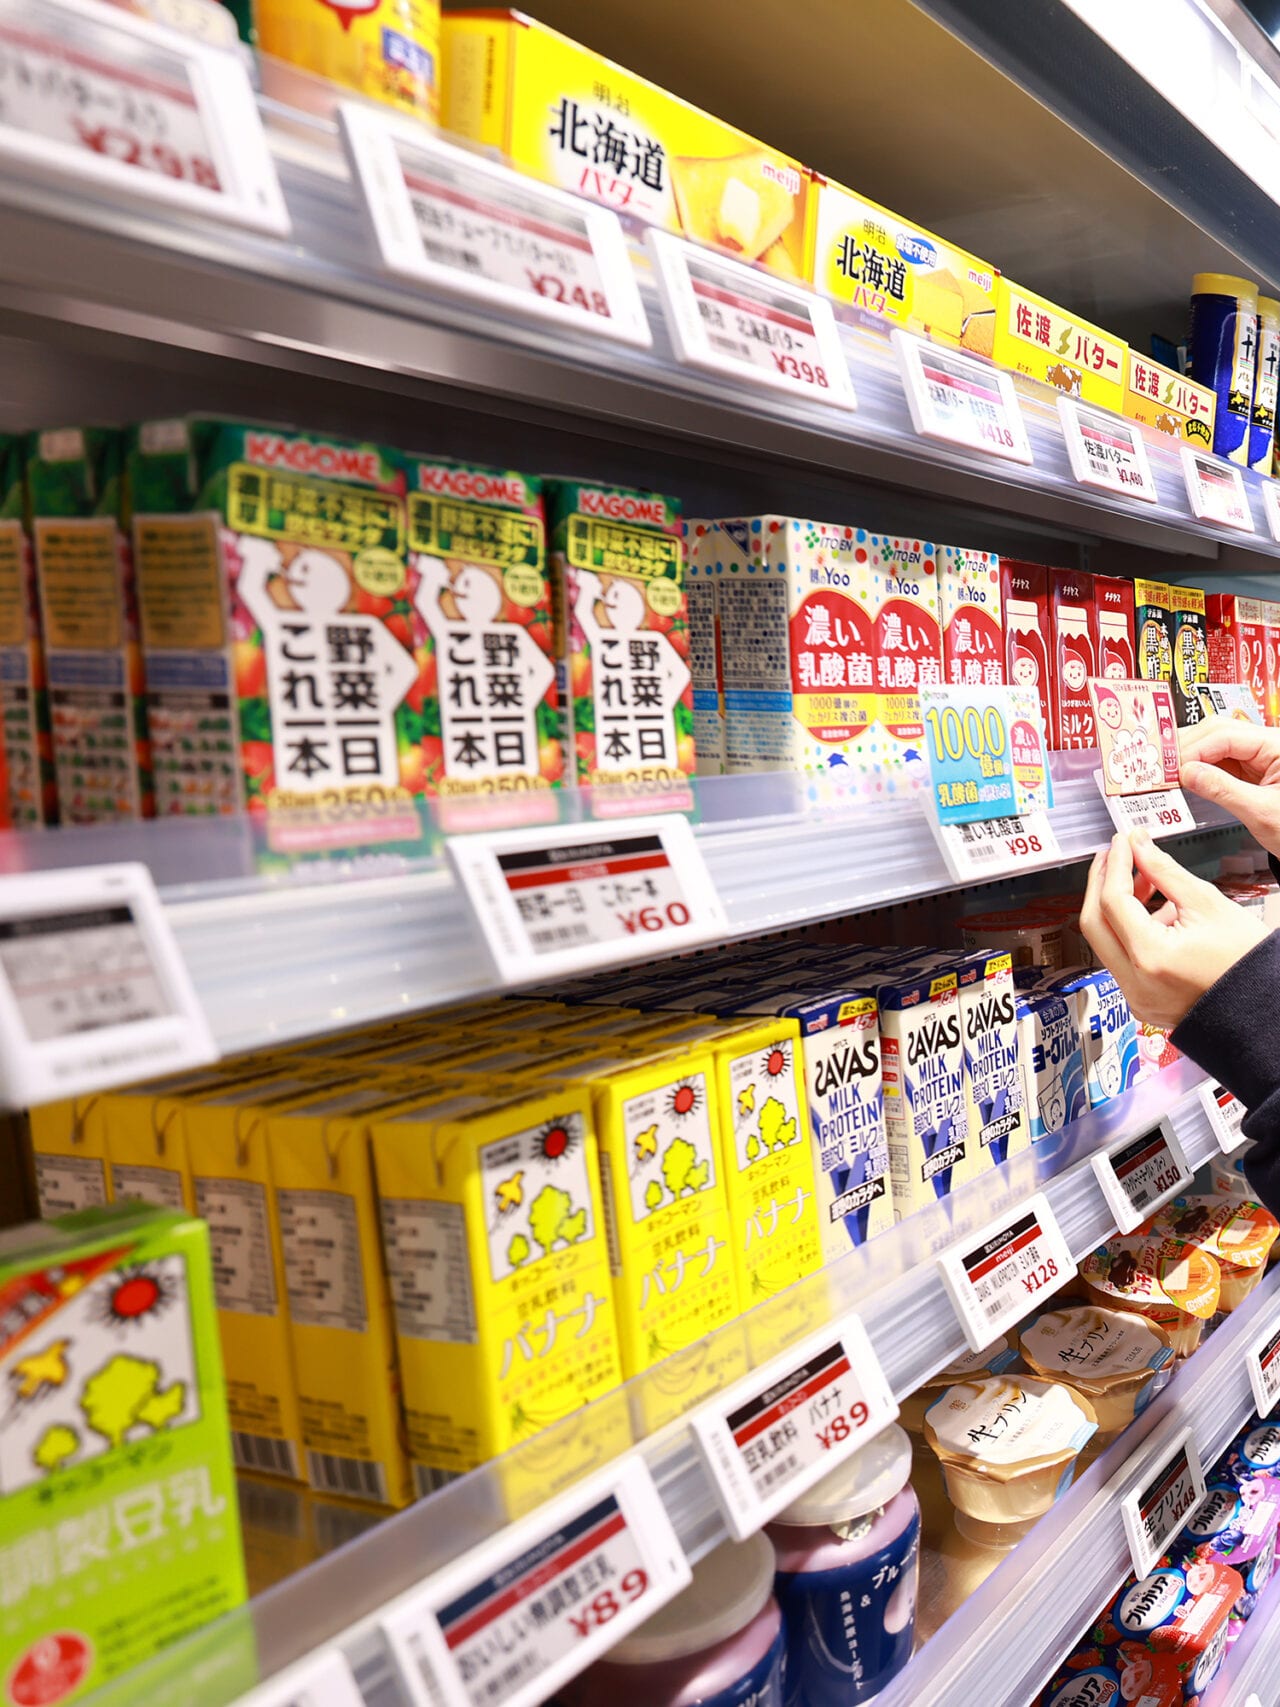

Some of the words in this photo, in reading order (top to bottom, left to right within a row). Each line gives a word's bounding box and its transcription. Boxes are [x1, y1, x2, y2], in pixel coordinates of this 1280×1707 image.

[549, 98, 665, 193] 北海道
[579, 167, 654, 210] バター
[762, 162, 801, 196] meiji
[863, 218, 887, 245] 明治
[836, 235, 907, 301] 北海道
[895, 233, 938, 268] 食塩不使用
[527, 266, 611, 317] ¥248
[968, 268, 993, 292] meiji
[852, 287, 899, 316] バター
[1016, 303, 1052, 347] 佐渡
[1075, 335, 1119, 370] バター
[771, 351, 830, 388] ¥398
[1134, 363, 1160, 398] 佐渡
[1176, 386, 1209, 419] バター
[979, 419, 1015, 448] ¥418
[245, 432, 379, 480] KAGOME
[1084, 438, 1131, 466] 佐渡バター
[420, 466, 524, 502] KAGOME
[579, 489, 666, 524] KAGOME
[820, 537, 839, 551] ITO
[838, 538, 852, 552] EN
[892, 551, 908, 561] ITO
[908, 552, 921, 564] EN
[965, 560, 978, 571] ITO
[976, 562, 988, 573] EN
[1011, 578, 1030, 590] チチヤス
[1062, 586, 1079, 598] チチヤス
[1104, 592, 1121, 603] チチヤス
[798, 651, 873, 689] 乳酸菌
[877, 655, 941, 689] 乳酸菌
[950, 659, 1002, 686] 乳酸菌
[279, 623, 331, 779] これ一本
[326, 625, 382, 776] 野菜一日
[448, 633, 488, 768] これ一本
[482, 633, 525, 767] 野菜一日
[599, 639, 631, 761] これ一本
[628, 639, 666, 760] 野菜一日
[926, 706, 1005, 761] 1000
[1063, 714, 1093, 735] ミルク
[1013, 749, 1042, 763] 乳酸菌
[1156, 809, 1182, 825] ¥98
[1005, 835, 1043, 856] ¥98
[617, 902, 691, 935] ¥60
[960, 969, 977, 984] meiji
[901, 991, 920, 1005] meiji
[967, 992, 1015, 1040] SAVAS
[806, 1014, 829, 1032] meiji
[908, 1014, 961, 1066] SAVAS
[977, 1029, 1003, 1057] MILK
[1032, 1027, 1079, 1073] ヨーグルト
[815, 1040, 879, 1097] SAVAS
[918, 1053, 947, 1083] MILK
[972, 1045, 1016, 1083] PROTEIN
[828, 1082, 862, 1117] MILK
[913, 1069, 962, 1113] PROTEIN
[820, 1100, 880, 1147] PROTEIN
[747, 1153, 792, 1182] キッコーマン
[1154, 1165, 1181, 1193] ¥150
[752, 1176, 791, 1204] 豆乳飲料
[647, 1200, 703, 1232] キッコーマン
[743, 1186, 811, 1251] バナナ
[652, 1225, 700, 1257] 豆乳飲料
[995, 1244, 1015, 1263] meiji
[511, 1254, 579, 1291] キッコーマン
[639, 1236, 726, 1311] バナナ
[1021, 1258, 1059, 1294] ¥128
[517, 1278, 577, 1320] 豆乳飲料
[499, 1292, 607, 1380] バナナ
[1057, 1321, 1109, 1364] 生プリン
[808, 1388, 842, 1426] バナナ
[967, 1391, 1027, 1443] 生プリン
[815, 1401, 869, 1450] ¥89
[1250, 1428, 1280, 1461] ブルガリア
[1144, 1480, 1184, 1538] 生プリン
[1172, 1486, 1196, 1522] ¥148
[1192, 1491, 1227, 1531] ブルガリア
[567, 1567, 649, 1638] ¥89
[860, 1594, 872, 1608] &
[1125, 1576, 1169, 1626] ブルガリア
